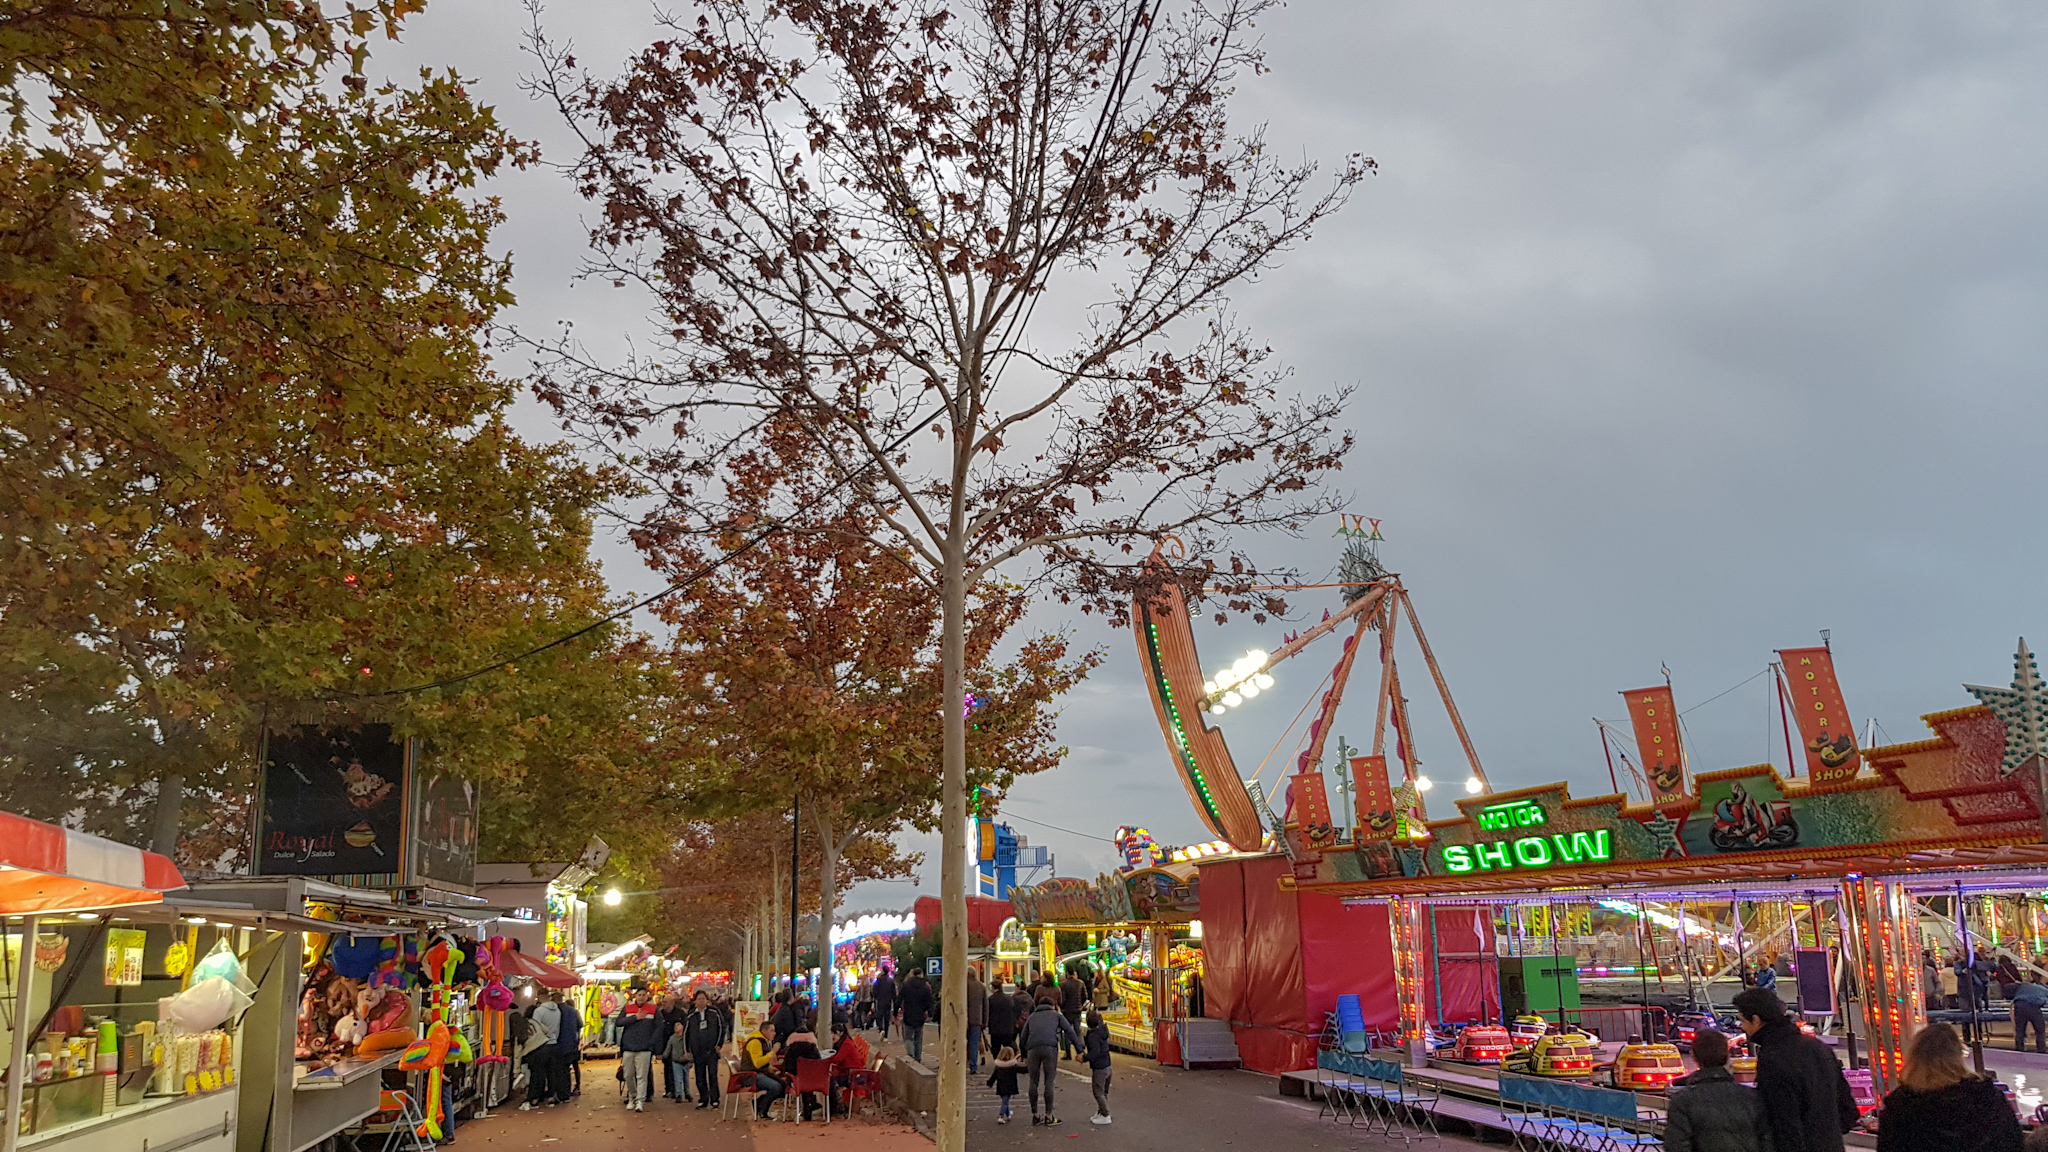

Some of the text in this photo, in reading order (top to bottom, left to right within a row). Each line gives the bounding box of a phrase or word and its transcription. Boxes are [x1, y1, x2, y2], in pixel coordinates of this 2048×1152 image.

[1800, 656, 1829, 727] MOTOR
[1642, 695, 1664, 757] MOTOR
[1363, 762, 1377, 806] MOTOR
[1815, 767, 1855, 781] SHOW
[1303, 778, 1317, 819] MOTOR
[1655, 792, 1682, 805] SHOW
[1477, 800, 1546, 831] MOTOR
[1306, 840, 1332, 850] SHOW
[1366, 830, 1395, 840] SHOW
[273, 851, 296, 859] Dulce
[310, 849, 336, 858] Salado
[1441, 828, 1611, 875] SHOW
[928, 959, 940, 974] P
